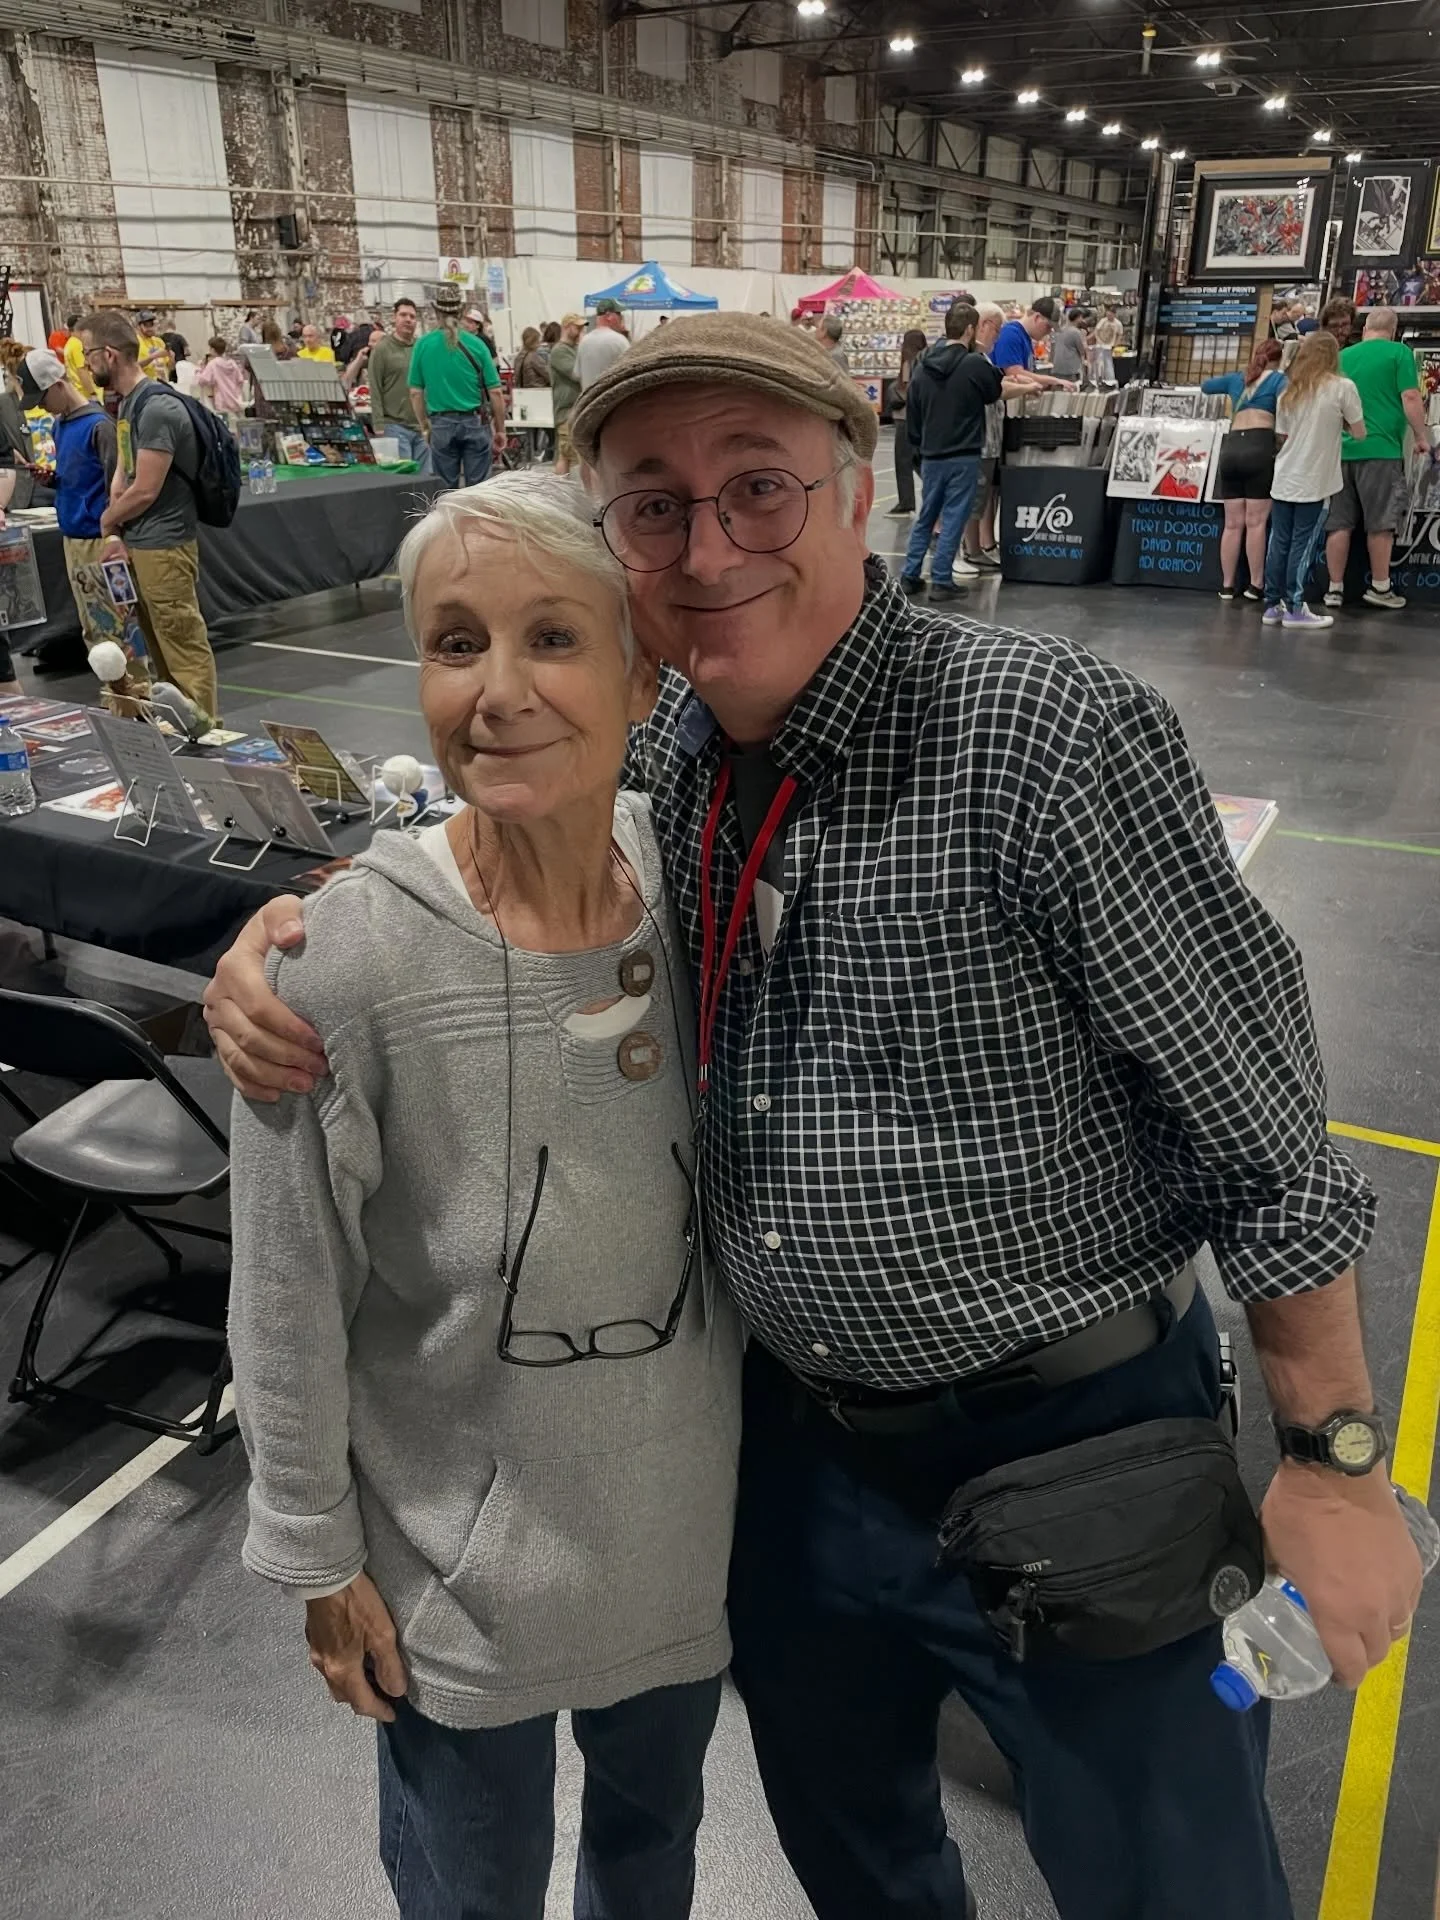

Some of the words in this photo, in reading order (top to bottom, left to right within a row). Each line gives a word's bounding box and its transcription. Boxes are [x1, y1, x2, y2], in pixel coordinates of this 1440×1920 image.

[1131, 519, 1160, 534] TERRY
[1164, 520, 1219, 538] DODSON
[1141, 537, 1172, 553] DAVID
